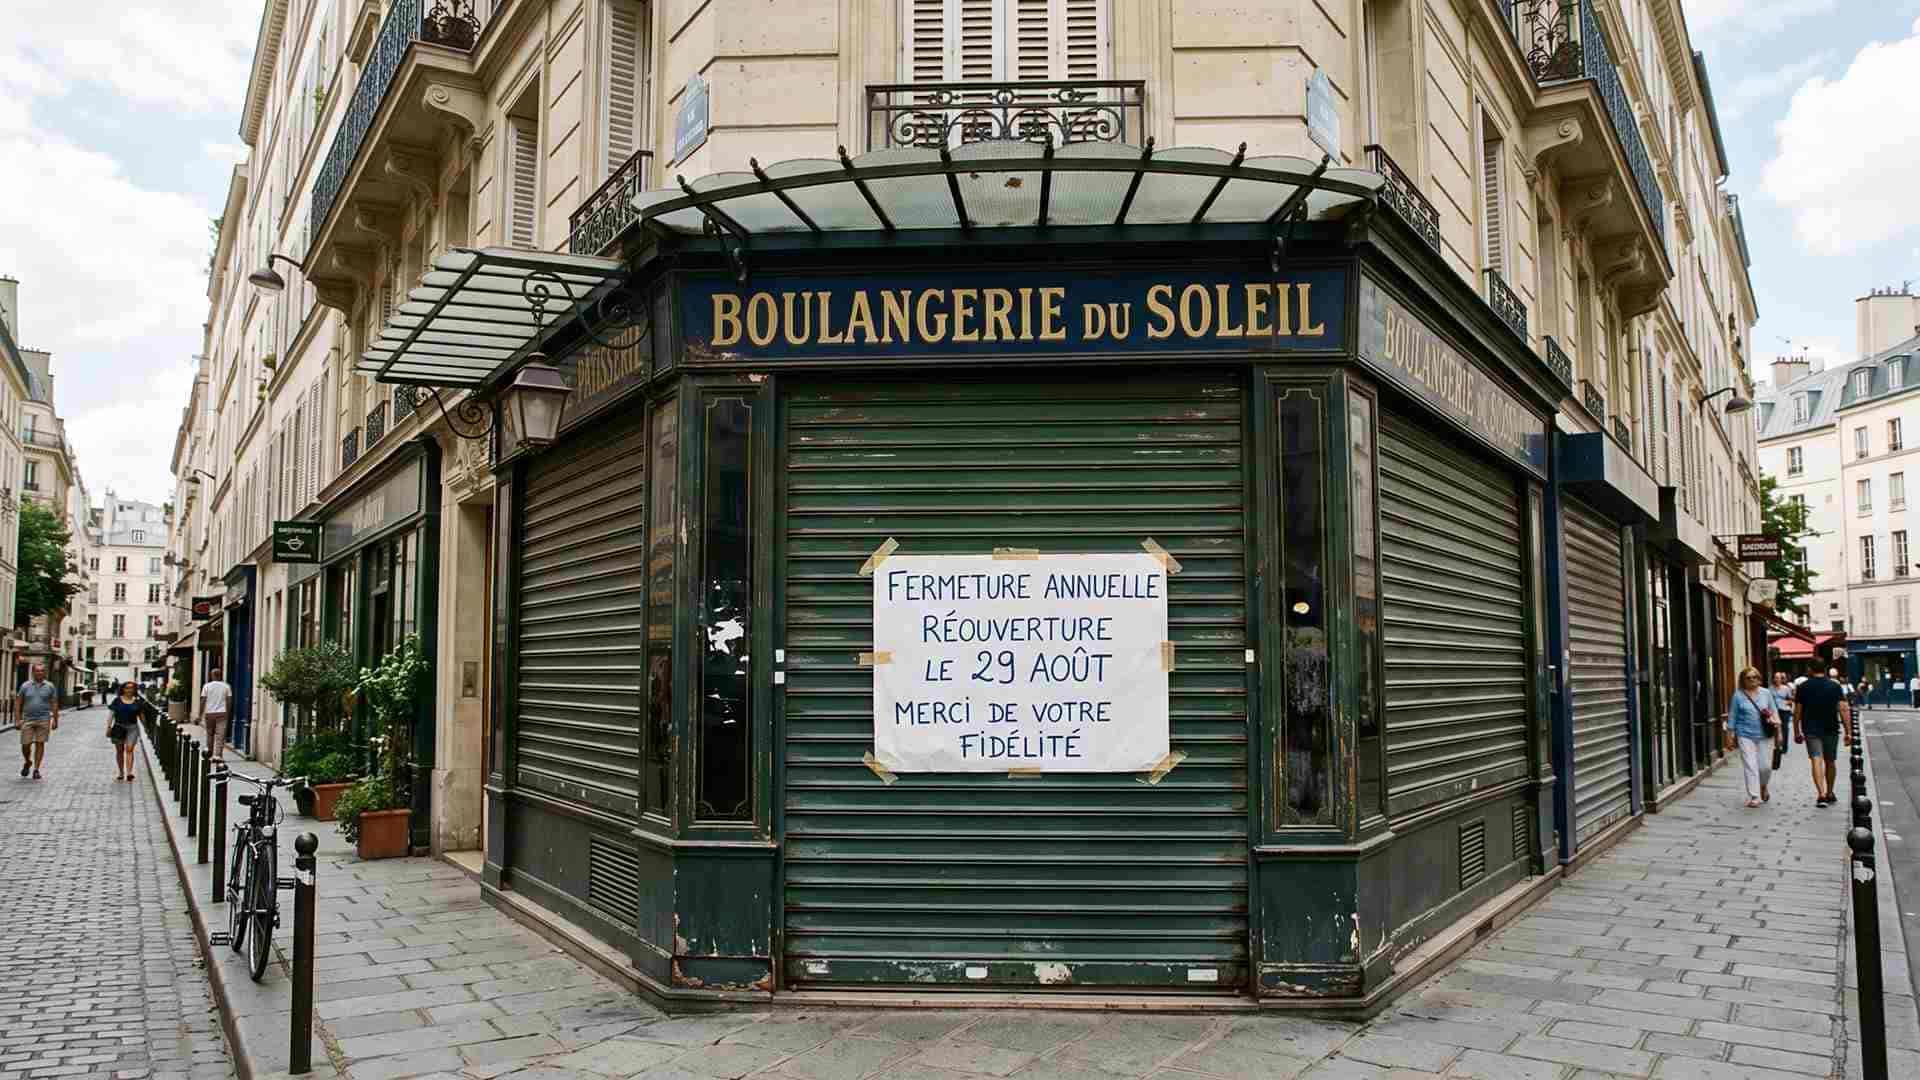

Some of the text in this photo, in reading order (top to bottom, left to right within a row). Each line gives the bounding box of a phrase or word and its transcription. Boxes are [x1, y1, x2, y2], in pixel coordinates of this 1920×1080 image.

[711, 284, 1324, 346] BOULANGERIE DU SOLEIL
[1384, 307, 1474, 416] BOULANGERIE
[888, 571, 1161, 601] FERMETURE ANNUELLE
[923, 610, 1113, 643] RÉOUVERTURE
[925, 647, 1113, 684] LE 29 AOÛT
[988, 702, 1018, 724] DE
[1032, 701, 1112, 723] VOTRE
